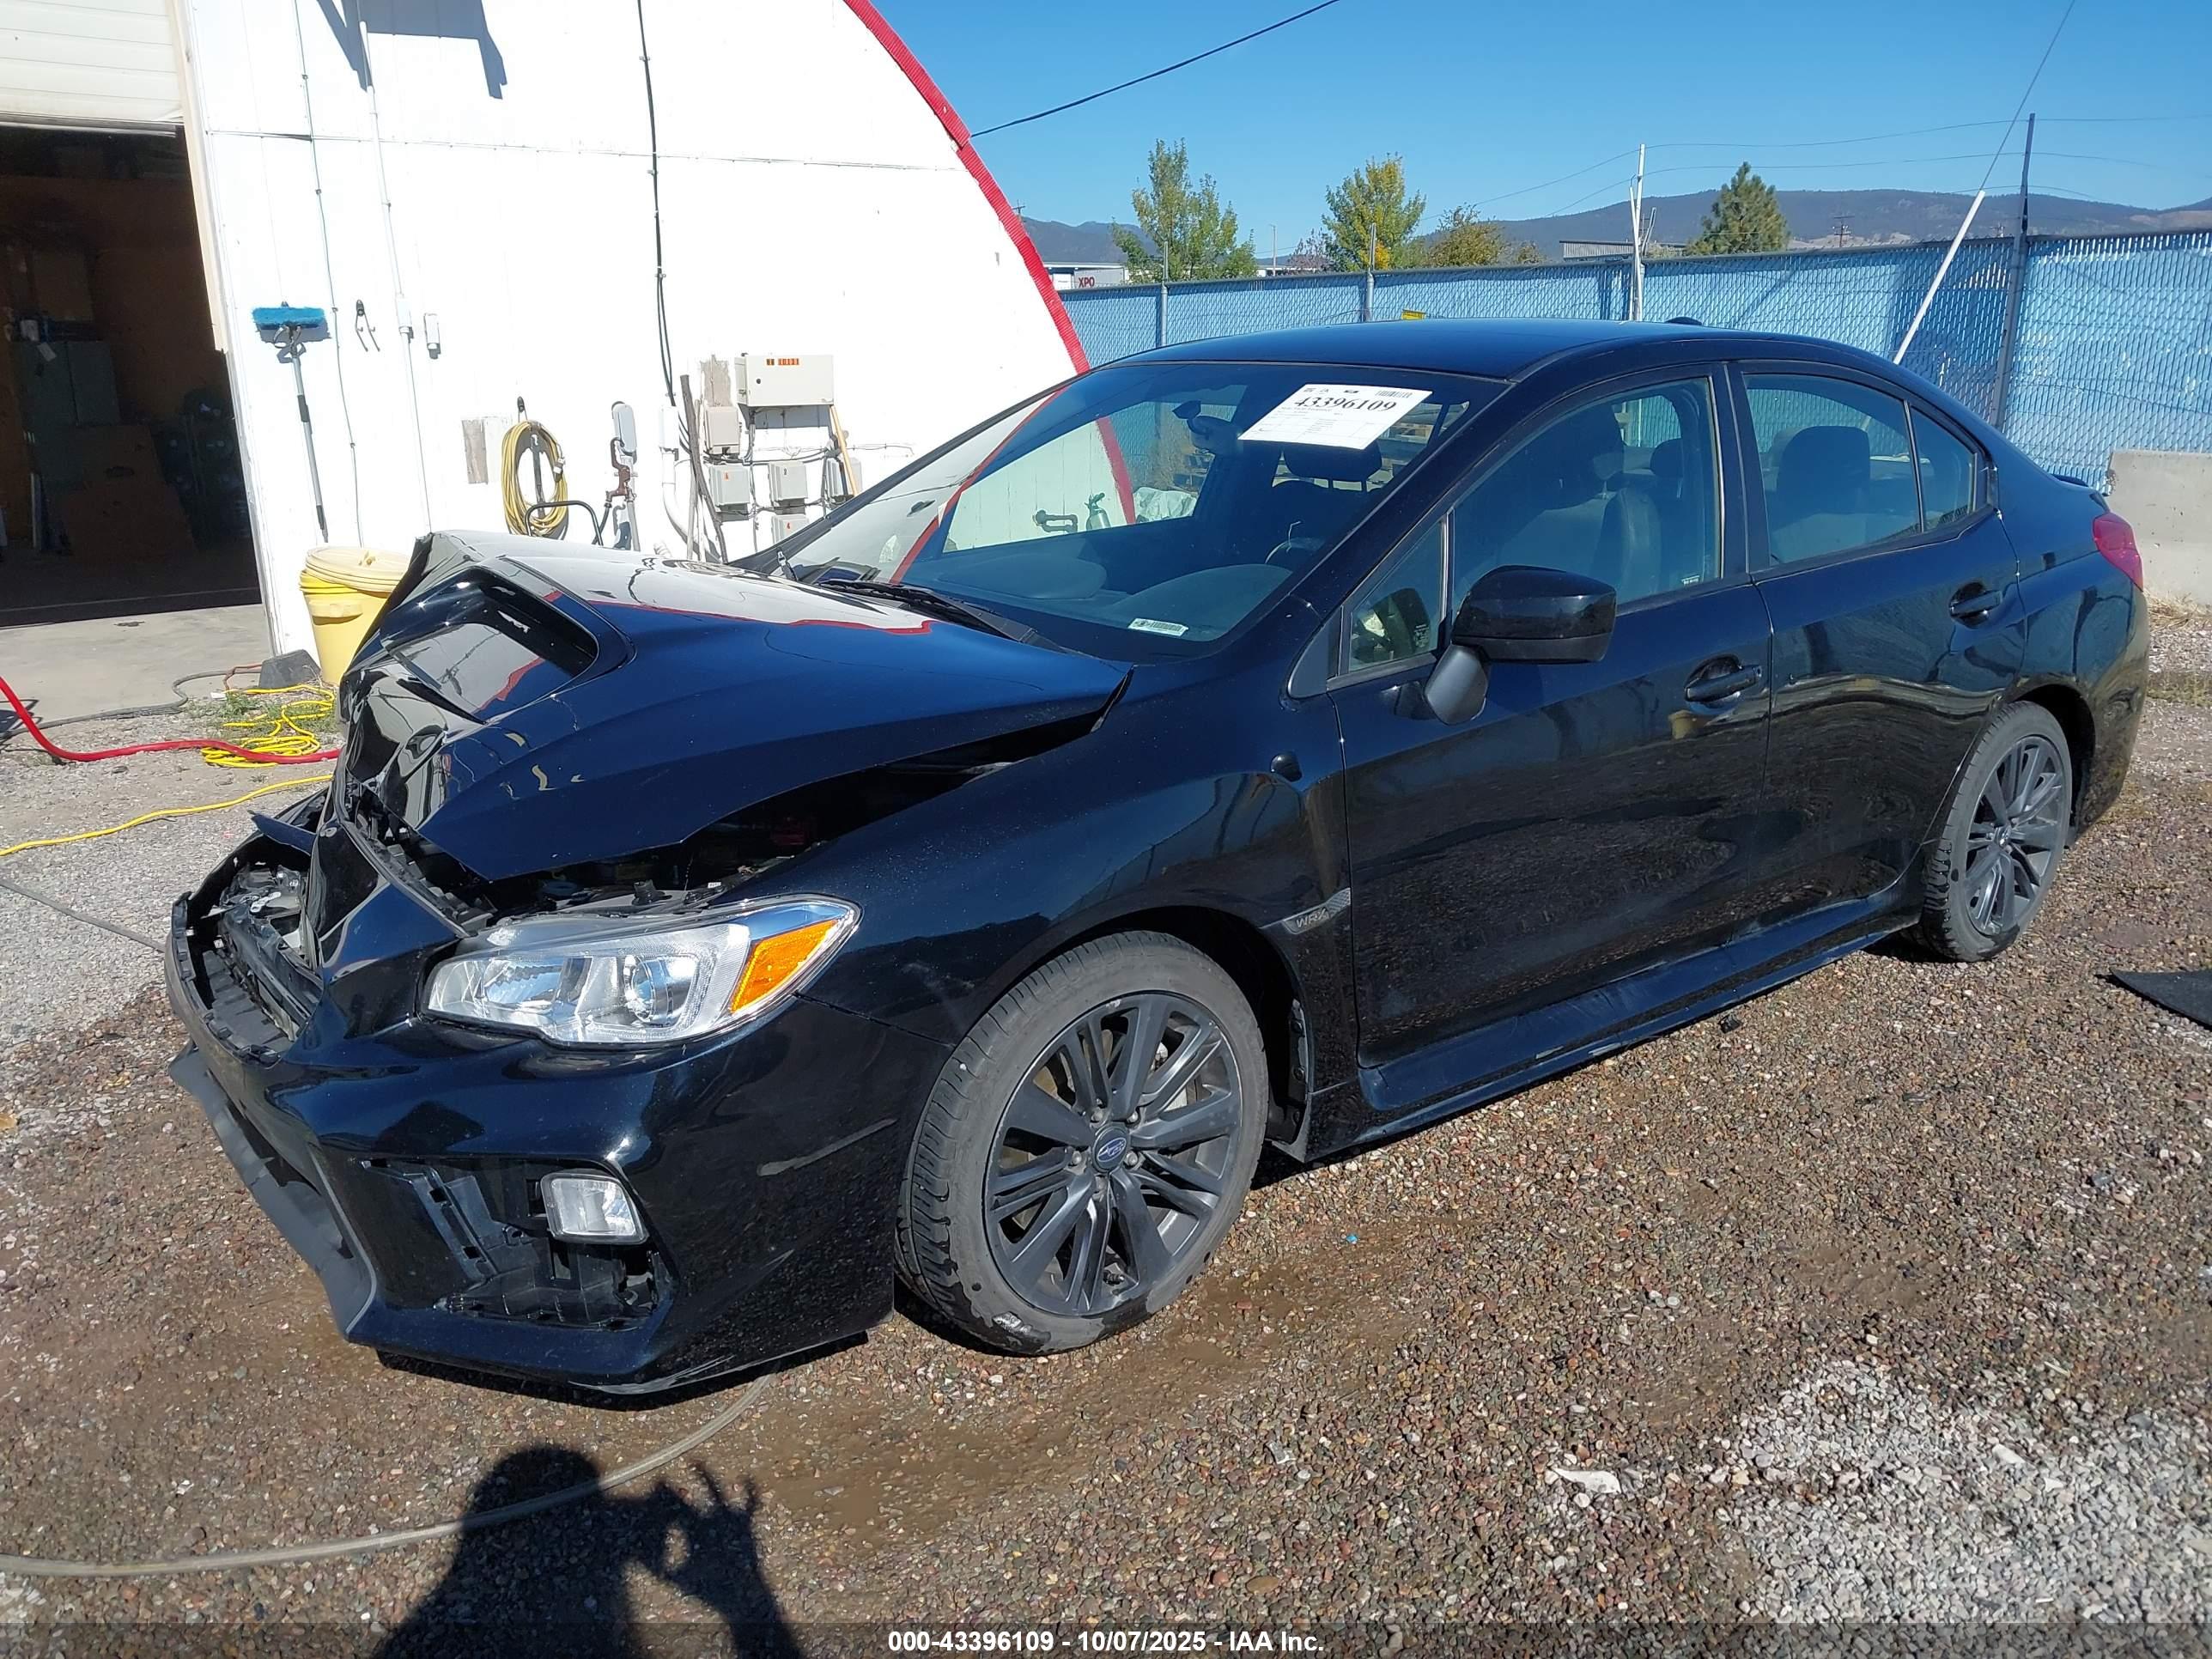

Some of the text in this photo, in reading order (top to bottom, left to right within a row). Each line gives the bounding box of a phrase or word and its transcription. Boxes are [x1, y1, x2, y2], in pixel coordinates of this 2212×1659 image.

[1079, 276, 1095, 288] XPO
[1294, 397, 1397, 411] 43396109
[1297, 908, 1329, 927] WRX
